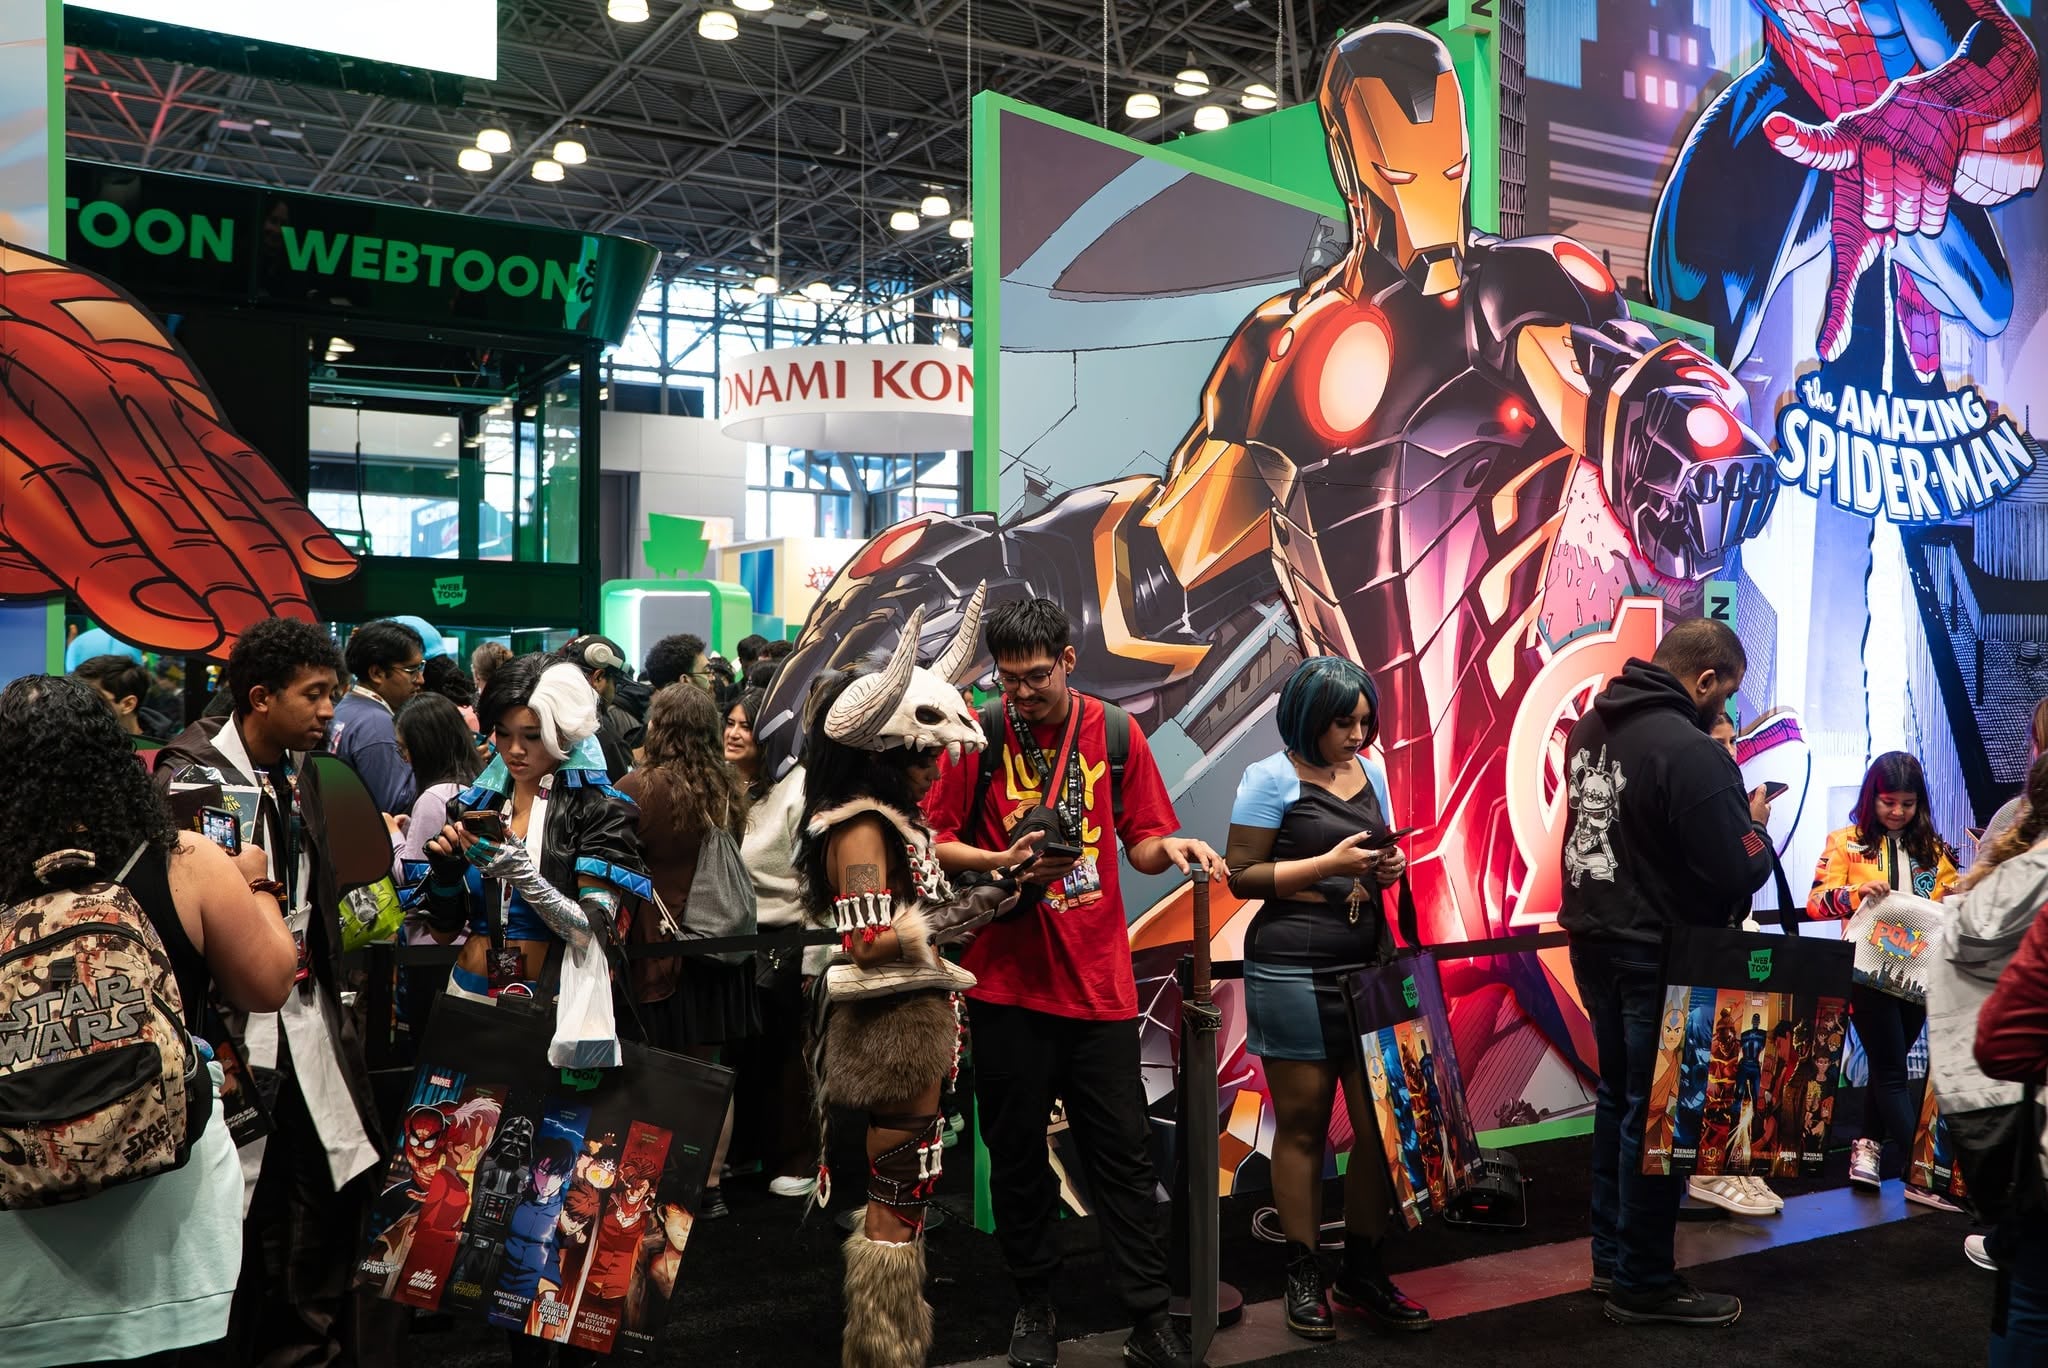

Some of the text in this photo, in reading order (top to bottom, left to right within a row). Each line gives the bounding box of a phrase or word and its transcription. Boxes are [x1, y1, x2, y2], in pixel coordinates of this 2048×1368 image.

[66, 197, 580, 303] OON WEBTOON
[1802, 379, 1989, 444] the AMAZING
[1780, 411, 2032, 518] SPIDER-MAN
[440, 583, 460, 592] WEB
[437, 591, 463, 599] TOON
[1003, 744, 1106, 811] LUY
[1872, 921, 1928, 960] POW!
[1754, 956, 1769, 965] WEB
[1751, 964, 1769, 973] TOON
[0, 974, 144, 1031] STAR
[0, 1000, 147, 1066] WARS
[120, 1115, 170, 1156] STAR
[411, 1270, 438, 1283] MAFIA
[408, 1278, 438, 1291] NANNY
[493, 1290, 531, 1305] OMNISCIENT
[498, 1298, 522, 1310] READER
[541, 1298, 570, 1311] DUNGEON
[537, 1304, 570, 1320] CRAWLER
[586, 1311, 617, 1325] GREATEST
[541, 1313, 561, 1327] CARL
[584, 1317, 607, 1329] ESTATE
[577, 1321, 611, 1336] DEVELOPER
